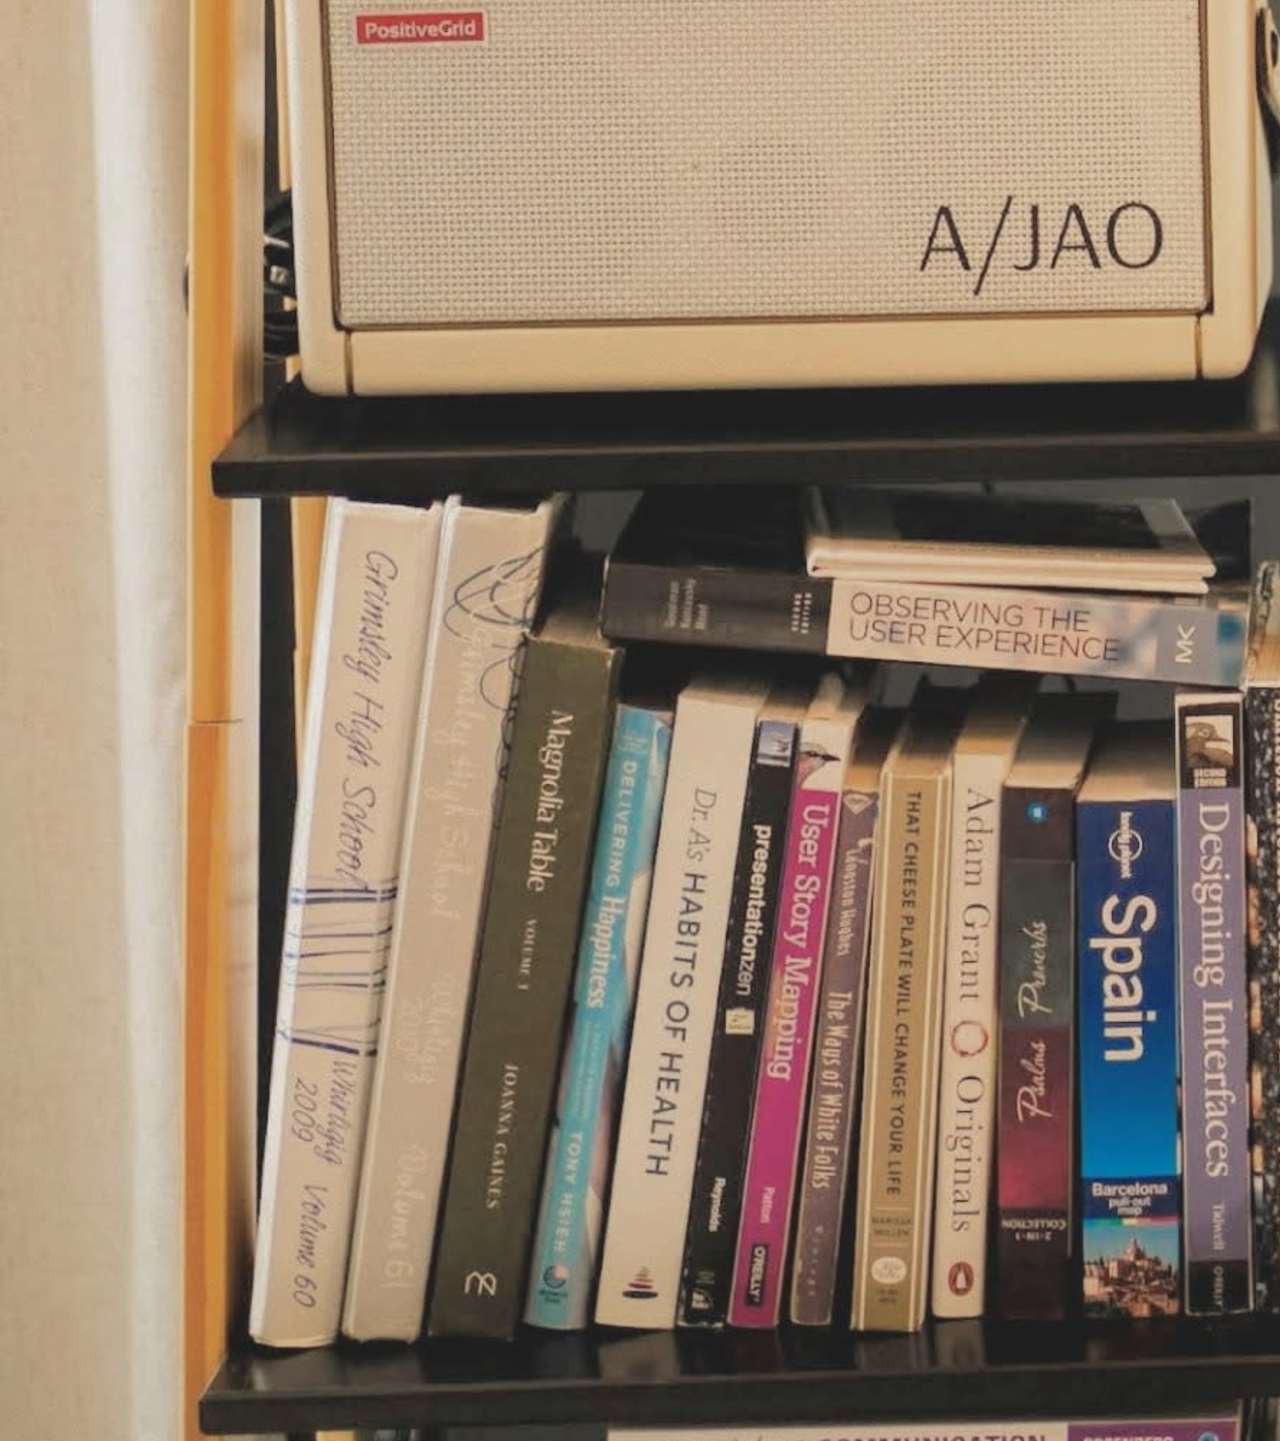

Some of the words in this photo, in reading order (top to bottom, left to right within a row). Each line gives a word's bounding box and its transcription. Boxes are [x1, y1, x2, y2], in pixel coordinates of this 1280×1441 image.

[365, 20, 476, 39] PositiveGrid
[920, 195, 1163, 296] A/JAO
[850, 592, 1023, 627] OBSERVING
[1034, 606, 1090, 633] THE
[850, 620, 926, 643] USER
[935, 625, 1120, 662] EXPERIENCE
[335, 691, 383, 767] High
[536, 711, 573, 824] Magnolia
[336, 778, 377, 894] School
[692, 788, 717, 823] Dr.
[798, 804, 829, 868] User
[905, 792, 922, 835] THAT
[964, 789, 994, 886] Adam
[527, 826, 558, 893] Table
[687, 830, 711, 863] A's
[903, 843, 919, 908] CHEESE
[671, 873, 705, 989] HABITS
[784, 875, 821, 947] Story
[1192, 803, 1230, 987] Designing
[900, 916, 915, 969] PLATE
[960, 904, 992, 1001] Grant
[1018, 922, 1053, 1018] Proverbs
[1090, 895, 1156, 1061] Spain
[665, 1001, 689, 1042] OF
[767, 954, 812, 1081] Mapping
[897, 974, 912, 1016] WILL
[891, 1024, 909, 1098] CHANGE
[1016, 1040, 1052, 1123] Psalms
[1202, 1000, 1235, 1177] Interfaces
[292, 1079, 319, 1143] 2009
[645, 1051, 684, 1177] HEALTH
[888, 1102, 904, 1154] YOUR
[886, 1161, 902, 1195] LIFE
[947, 1076, 985, 1232] Originals
[1092, 1183, 1167, 1196] Barcelona
[296, 1185, 328, 1268] Volume
[294, 1274, 317, 1308] 60
